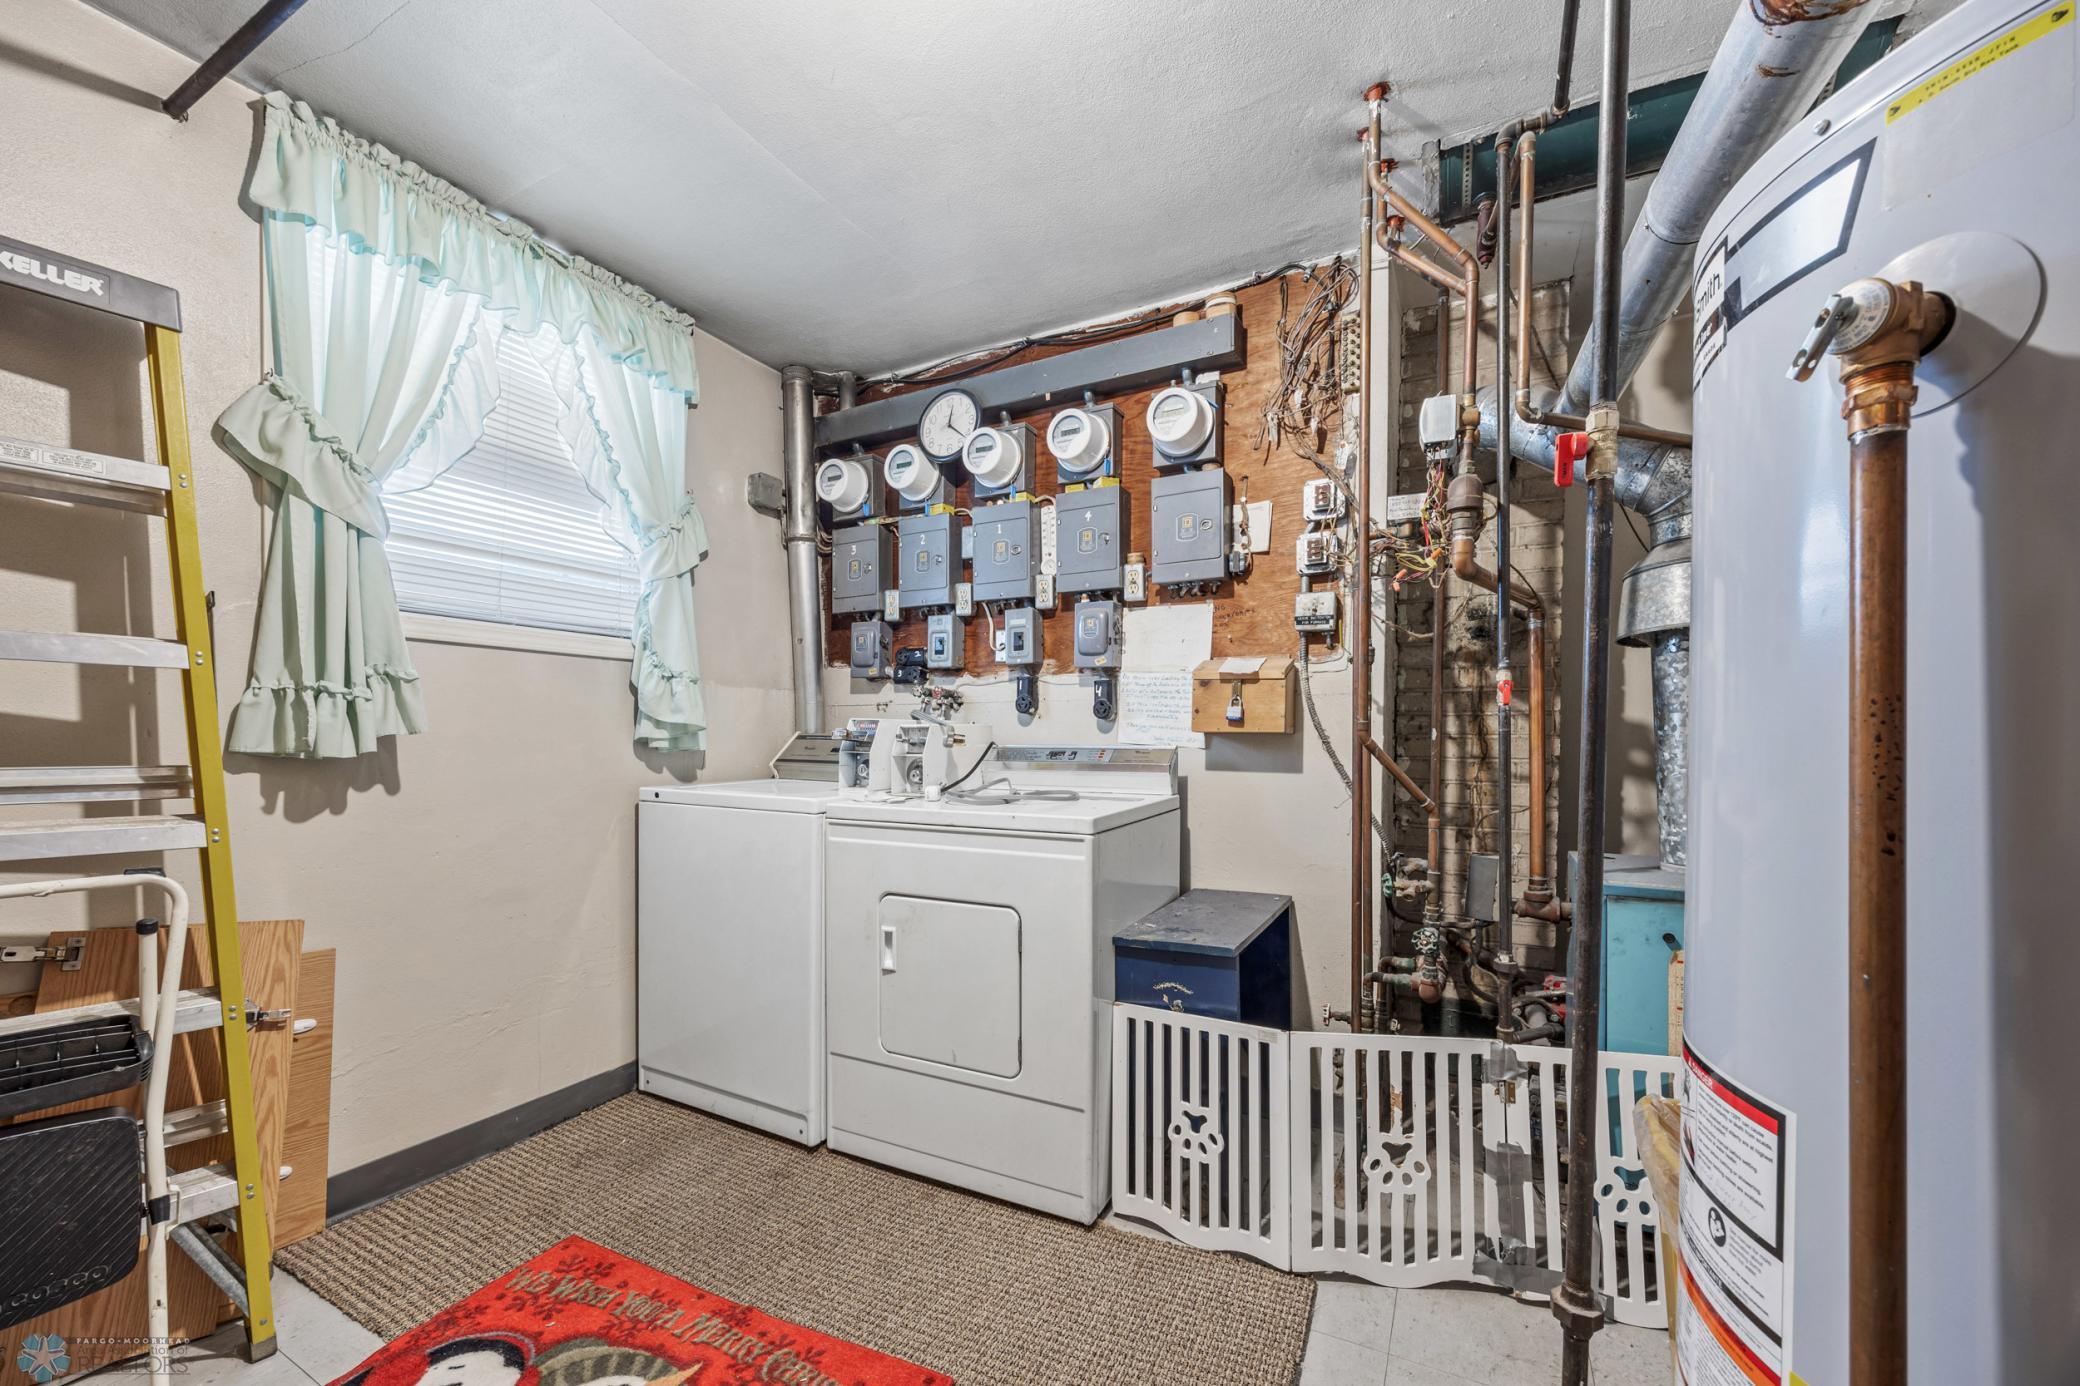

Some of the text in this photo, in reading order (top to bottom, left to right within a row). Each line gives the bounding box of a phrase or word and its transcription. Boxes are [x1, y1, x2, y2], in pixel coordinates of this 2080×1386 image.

[0, 250, 104, 296] KELLER
[920, 534, 926, 545] 2
[851, 545, 856, 556] 3
[1096, 684, 1102, 697] 4
[505, 1268, 553, 1294] WE
[549, 1274, 623, 1308] WISH
[609, 1291, 669, 1322] YOU
[654, 1308, 685, 1329] A
[671, 1313, 768, 1364] MERRY
